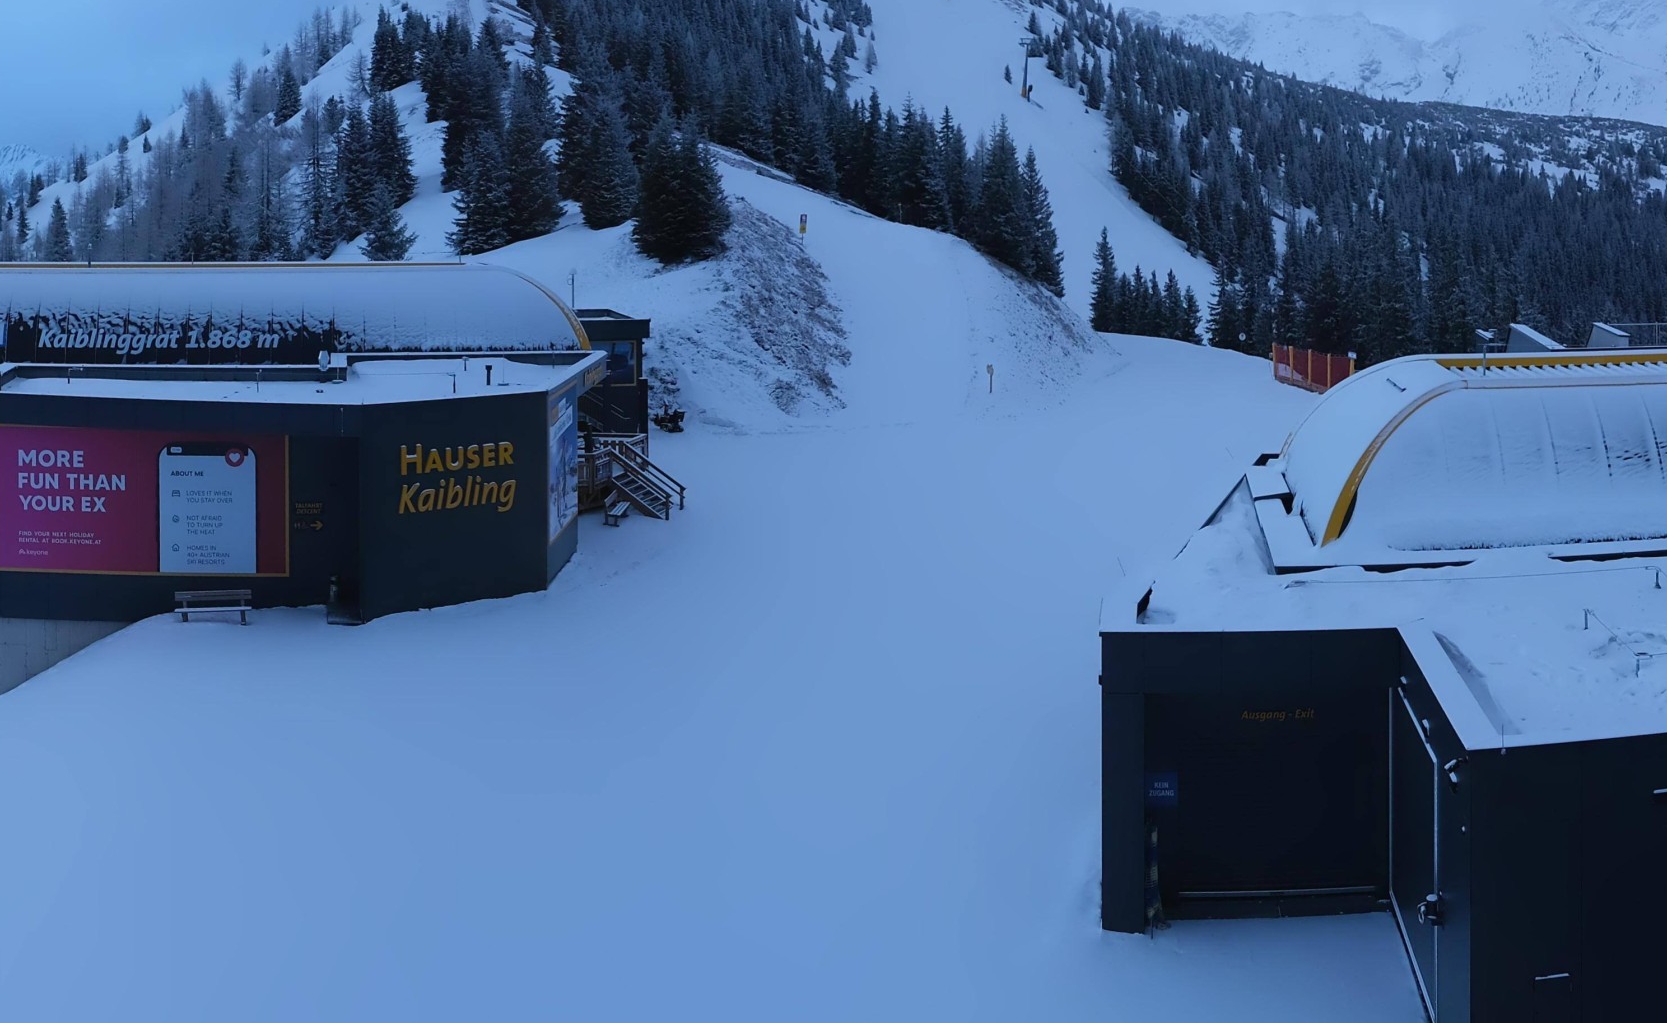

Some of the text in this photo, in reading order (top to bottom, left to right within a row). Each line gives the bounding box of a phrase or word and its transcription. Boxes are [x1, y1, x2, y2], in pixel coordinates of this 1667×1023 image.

[38, 328, 280, 354] Kaiblinggrat 1.868 m
[17, 449, 85, 468] MORE
[400, 441, 515, 476] HAUSER
[17, 472, 126, 491] FUN THAN
[19, 495, 106, 513] YOUR EX
[398, 475, 517, 515] Kaibling
[1241, 710, 1286, 722] Ausgang
[1295, 708, 1315, 719] Exit
[1149, 789, 1175, 797] ZUGANG
[1154, 781, 1169, 789] KEIN
